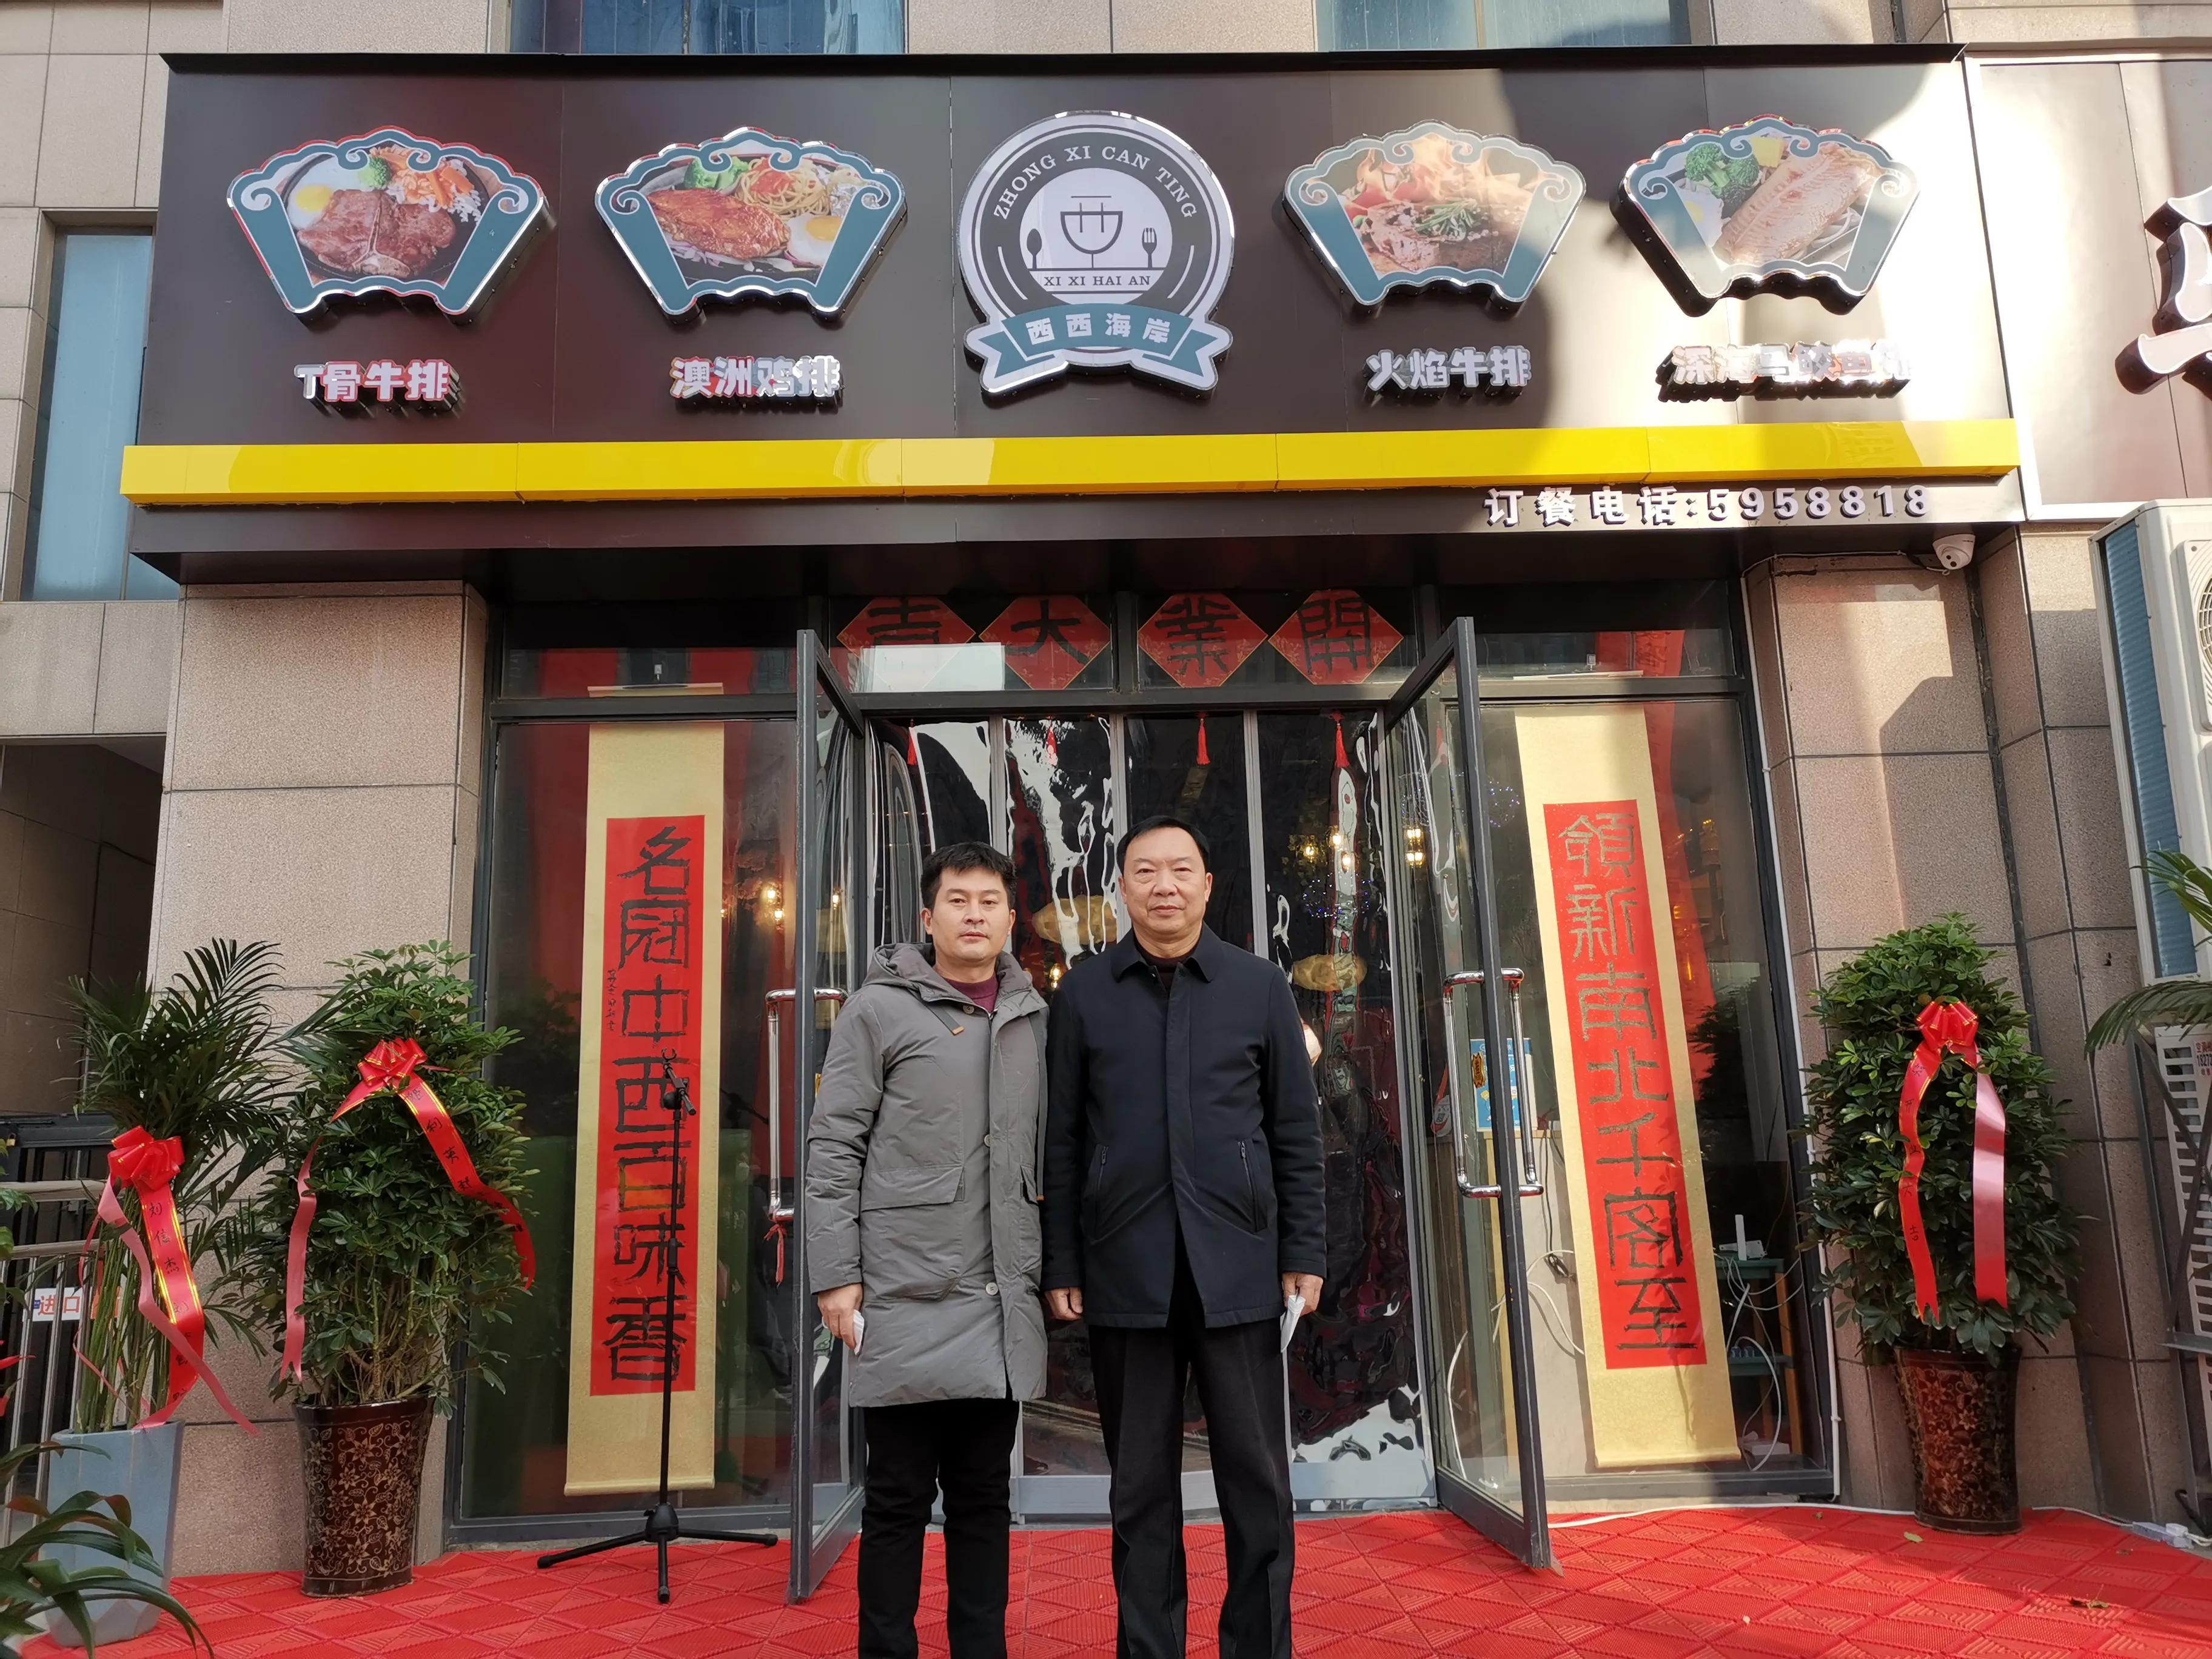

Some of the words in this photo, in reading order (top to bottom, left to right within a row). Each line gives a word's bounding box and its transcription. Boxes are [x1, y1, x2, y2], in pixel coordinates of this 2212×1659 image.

[993, 154, 1056, 220] ZHONG
[1064, 146, 1092, 162] XI
[1102, 146, 1151, 170] CAN
[1155, 167, 1198, 218] TING
[1044, 276, 1062, 287] XI
[1068, 276, 1086, 287] XI
[1093, 275, 1122, 286] HAI
[1128, 275, 1151, 286] AN
[1025, 312, 1171, 345] 西西海岸
[671, 355, 840, 398] 澳洲鸡排
[1367, 346, 1531, 390] 火焰牛排
[38, 1295, 81, 1316] 进口
